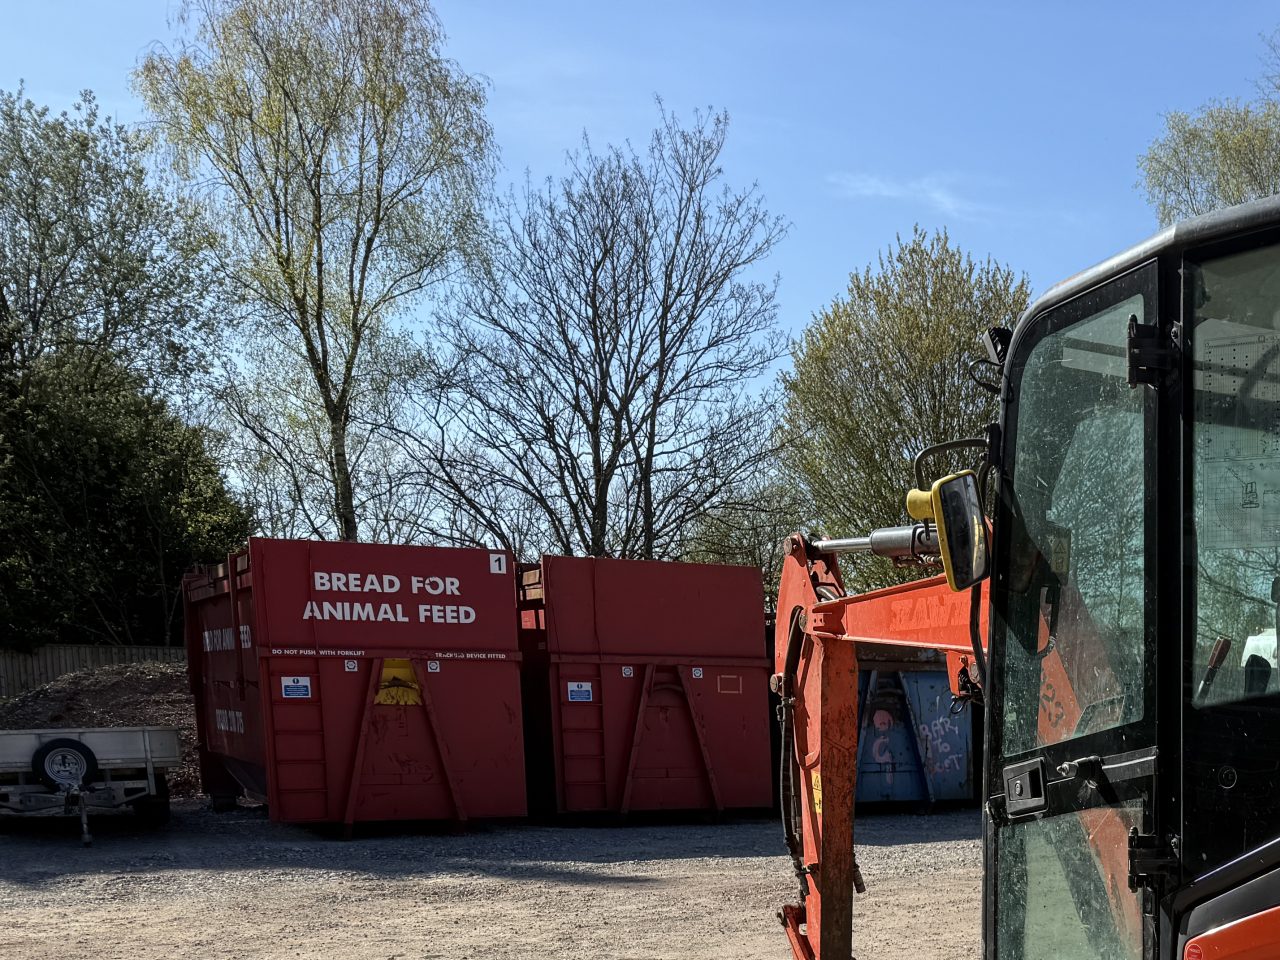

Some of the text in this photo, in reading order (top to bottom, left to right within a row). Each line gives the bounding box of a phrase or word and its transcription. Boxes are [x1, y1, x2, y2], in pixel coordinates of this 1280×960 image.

[493, 556, 502, 572] 1
[313, 571, 461, 596] BREAD FOR
[302, 601, 476, 624] ANIMAL FEED
